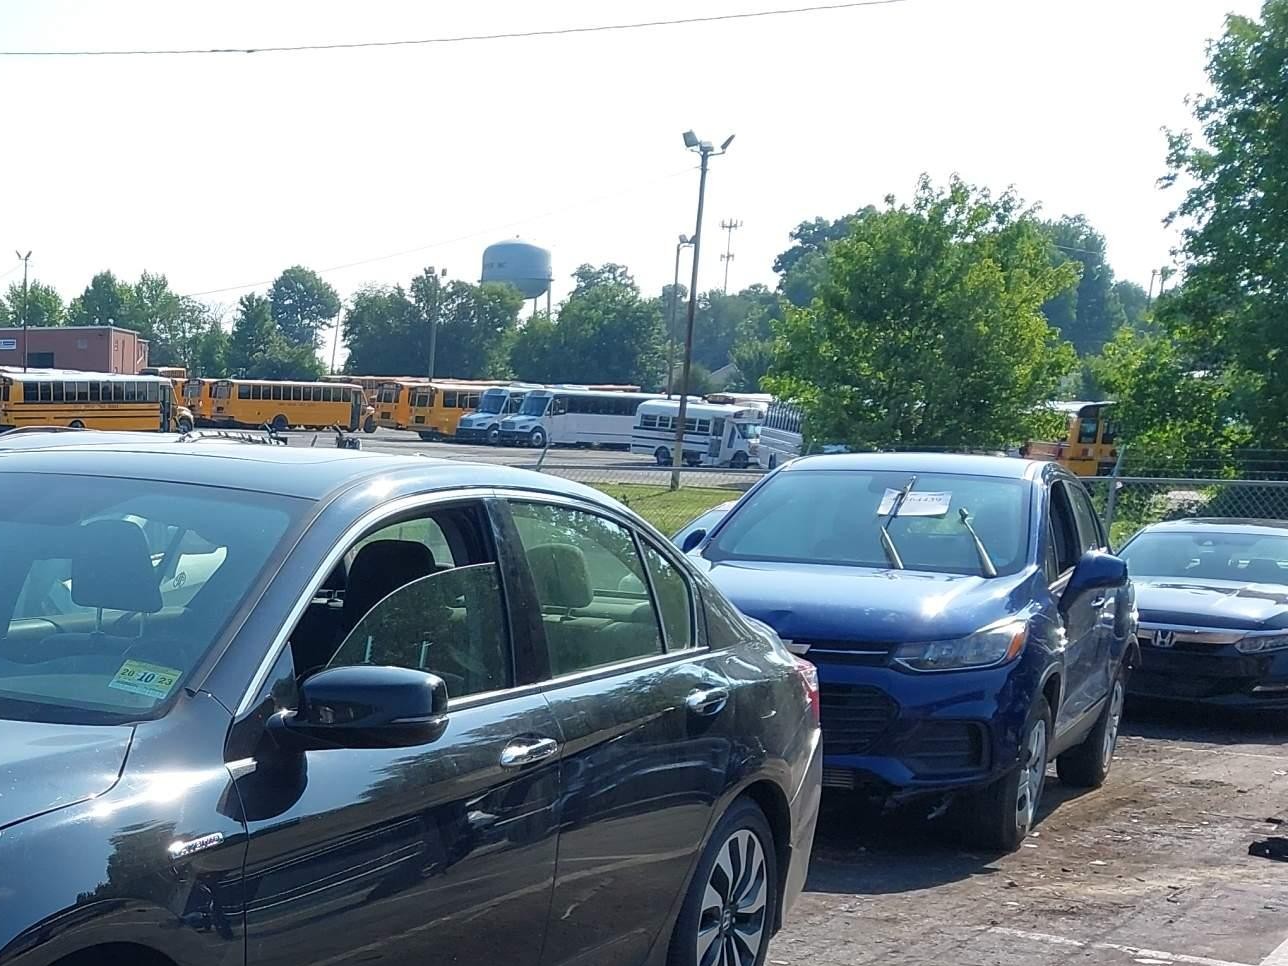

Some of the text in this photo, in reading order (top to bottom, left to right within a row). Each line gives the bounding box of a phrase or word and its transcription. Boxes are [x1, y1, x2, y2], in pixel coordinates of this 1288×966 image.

[121, 668, 172, 686] 20 10 23
